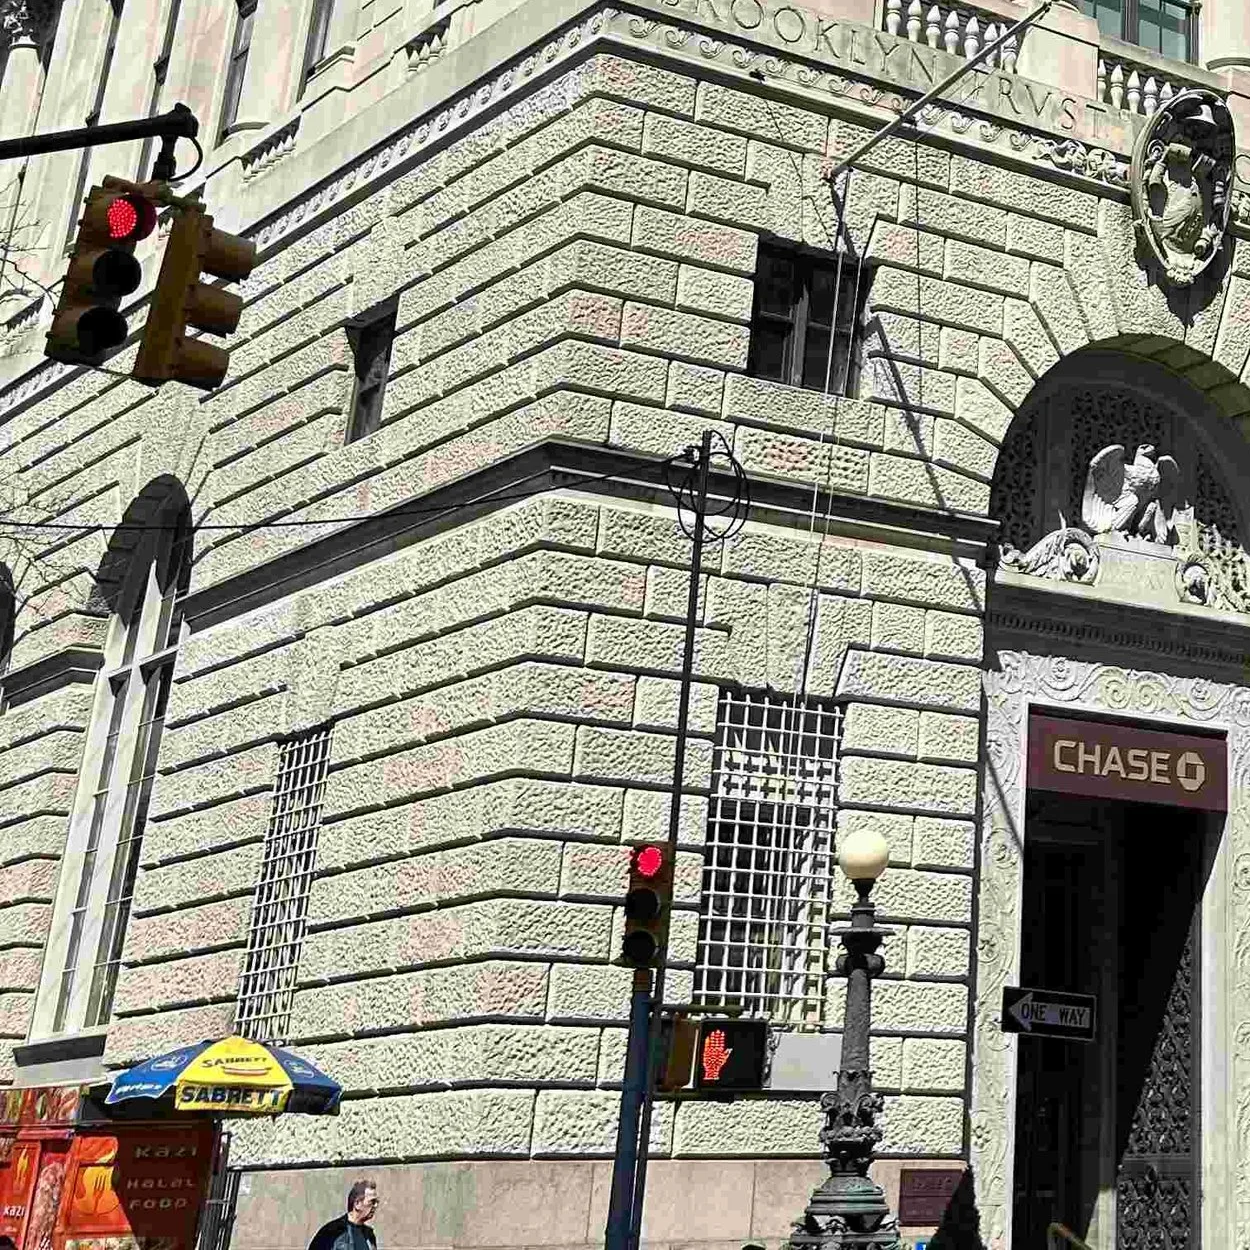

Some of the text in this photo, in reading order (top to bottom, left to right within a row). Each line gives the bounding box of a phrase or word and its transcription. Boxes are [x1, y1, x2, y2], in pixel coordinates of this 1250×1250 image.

[965, 67, 1107, 139] TRVST
[1053, 739, 1171, 784] CHASE
[1021, 1003, 1086, 1026] ONE WAY
[181, 1083, 282, 1105] SABRETT
[129, 1198, 189, 1210] FOOD
